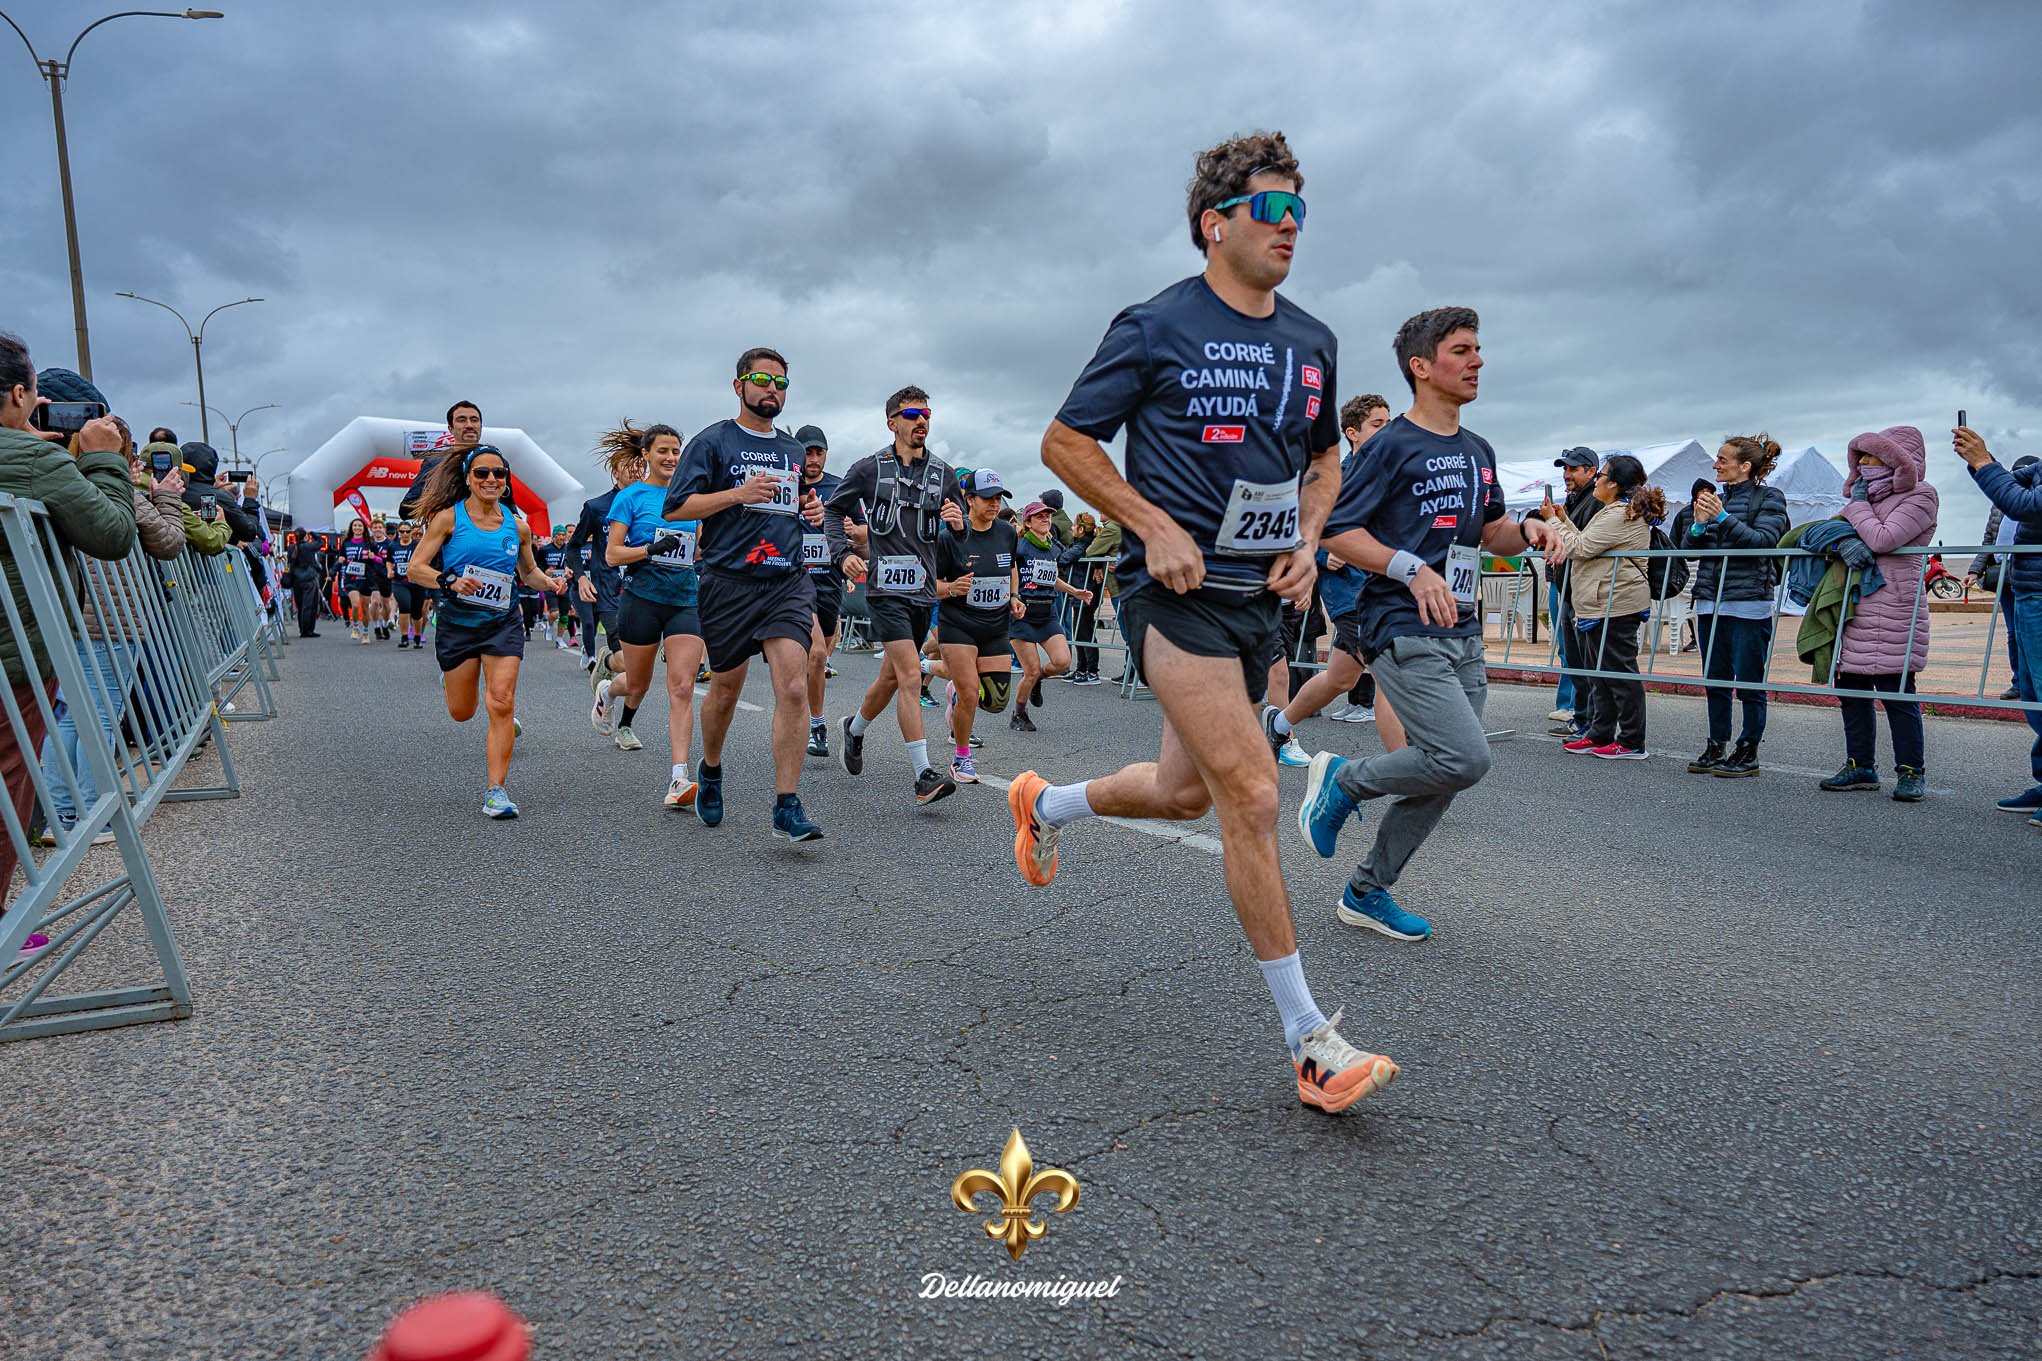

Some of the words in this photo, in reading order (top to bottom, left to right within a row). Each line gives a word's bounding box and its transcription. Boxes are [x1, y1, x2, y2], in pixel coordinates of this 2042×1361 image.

[1203, 342, 1275, 364] CORRÉ
[1180, 367, 1270, 390] CAMINÁ
[1186, 393, 1259, 417] AYUDÁ
[741, 451, 779, 462] CORRÉ
[1426, 453, 1468, 472] CORRÉ
[388, 471, 407, 479] new
[1412, 471, 1467, 496] CAMINÁ
[1420, 492, 1464, 516] AYUDÁ
[1234, 505, 1297, 541] 2345
[803, 545, 824, 559] 567
[884, 568, 916, 585] 2478
[475, 582, 503, 602] 524
[973, 588, 1001, 603] 3184
